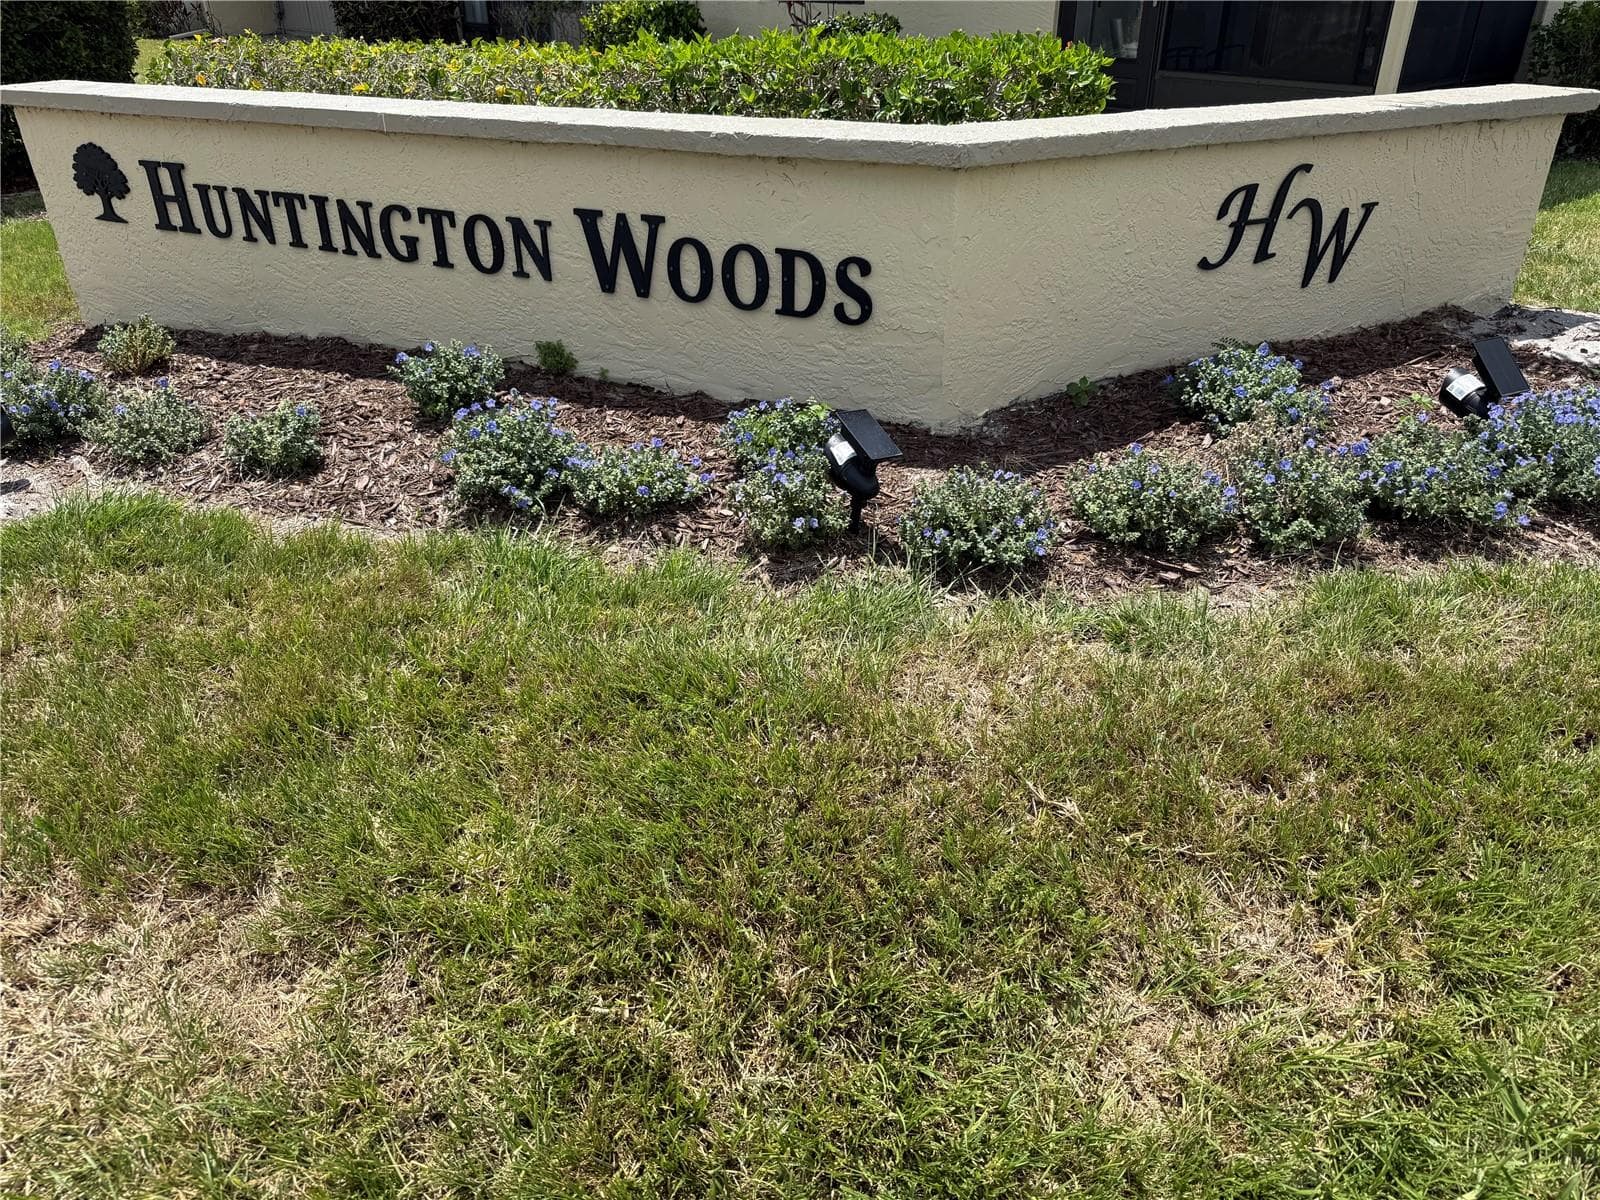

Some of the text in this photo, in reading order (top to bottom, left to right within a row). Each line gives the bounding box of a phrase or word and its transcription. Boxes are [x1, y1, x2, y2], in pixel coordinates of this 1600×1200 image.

[138, 159, 874, 327] HUNTINGTON WOODS
[1196, 163, 1379, 289] HW
